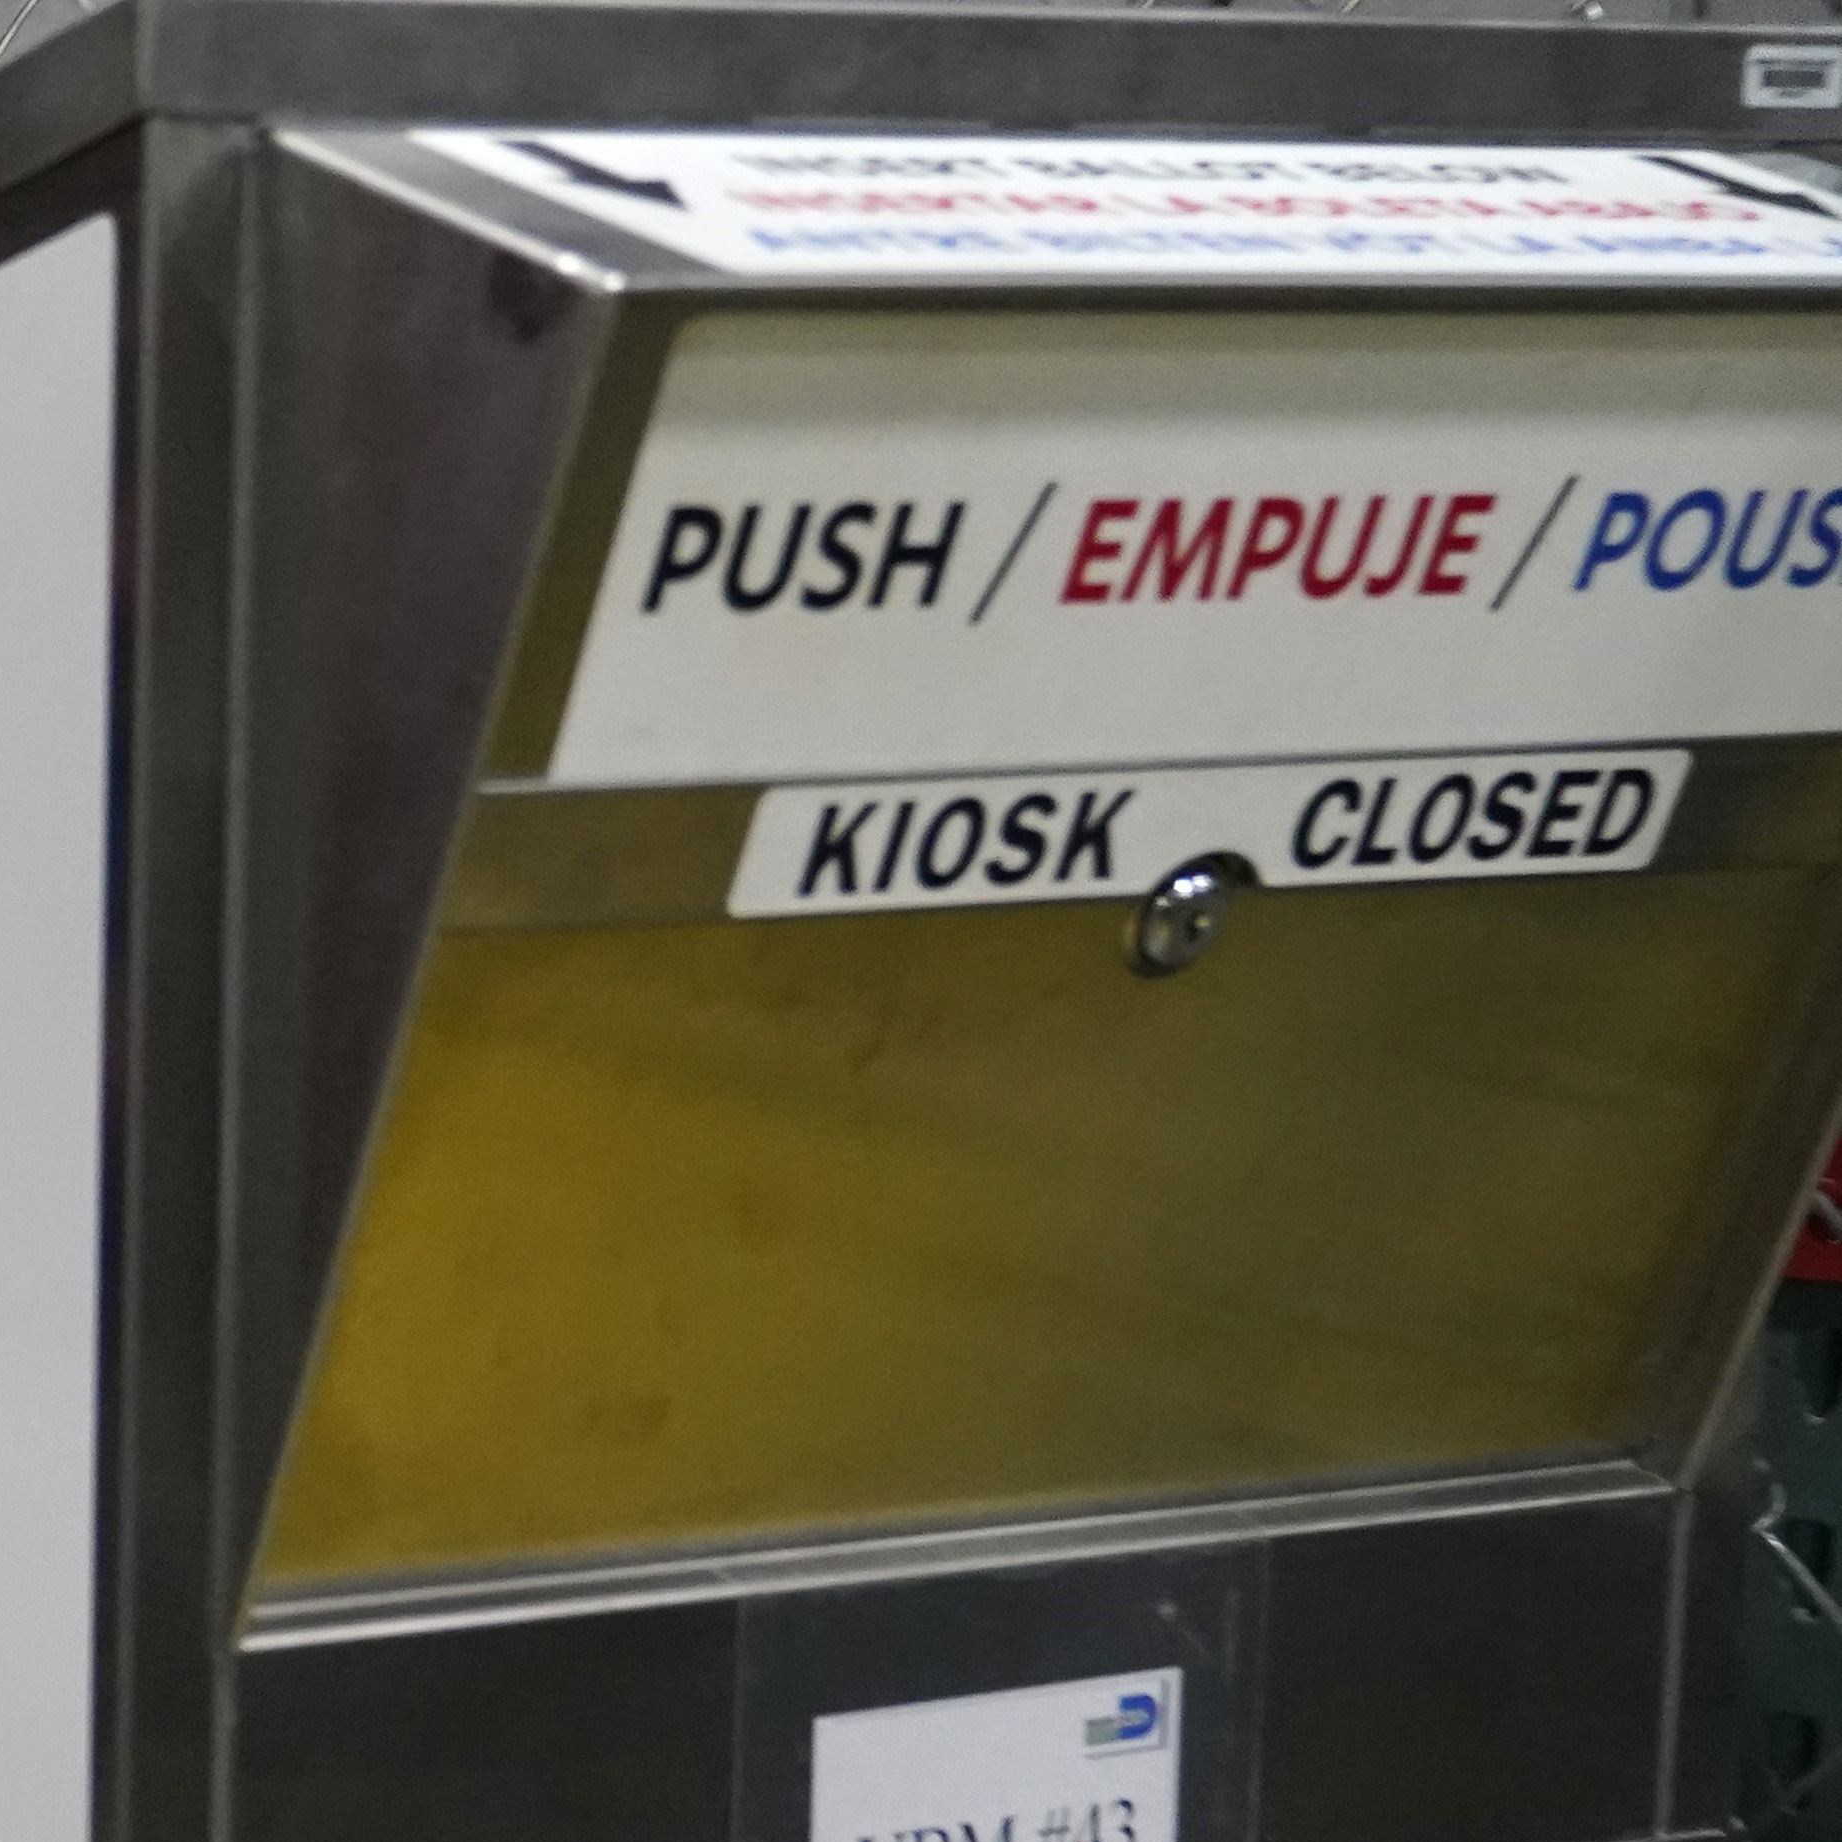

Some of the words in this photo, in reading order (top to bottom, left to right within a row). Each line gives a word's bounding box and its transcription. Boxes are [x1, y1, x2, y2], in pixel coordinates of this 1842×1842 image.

[640, 501, 965, 614] PUSH
[1060, 493, 1495, 604] EMPUJE
[1572, 487, 1842, 591] POUS
[798, 790, 1134, 897] KIOSK
[1293, 769, 1653, 870] CLOSED
